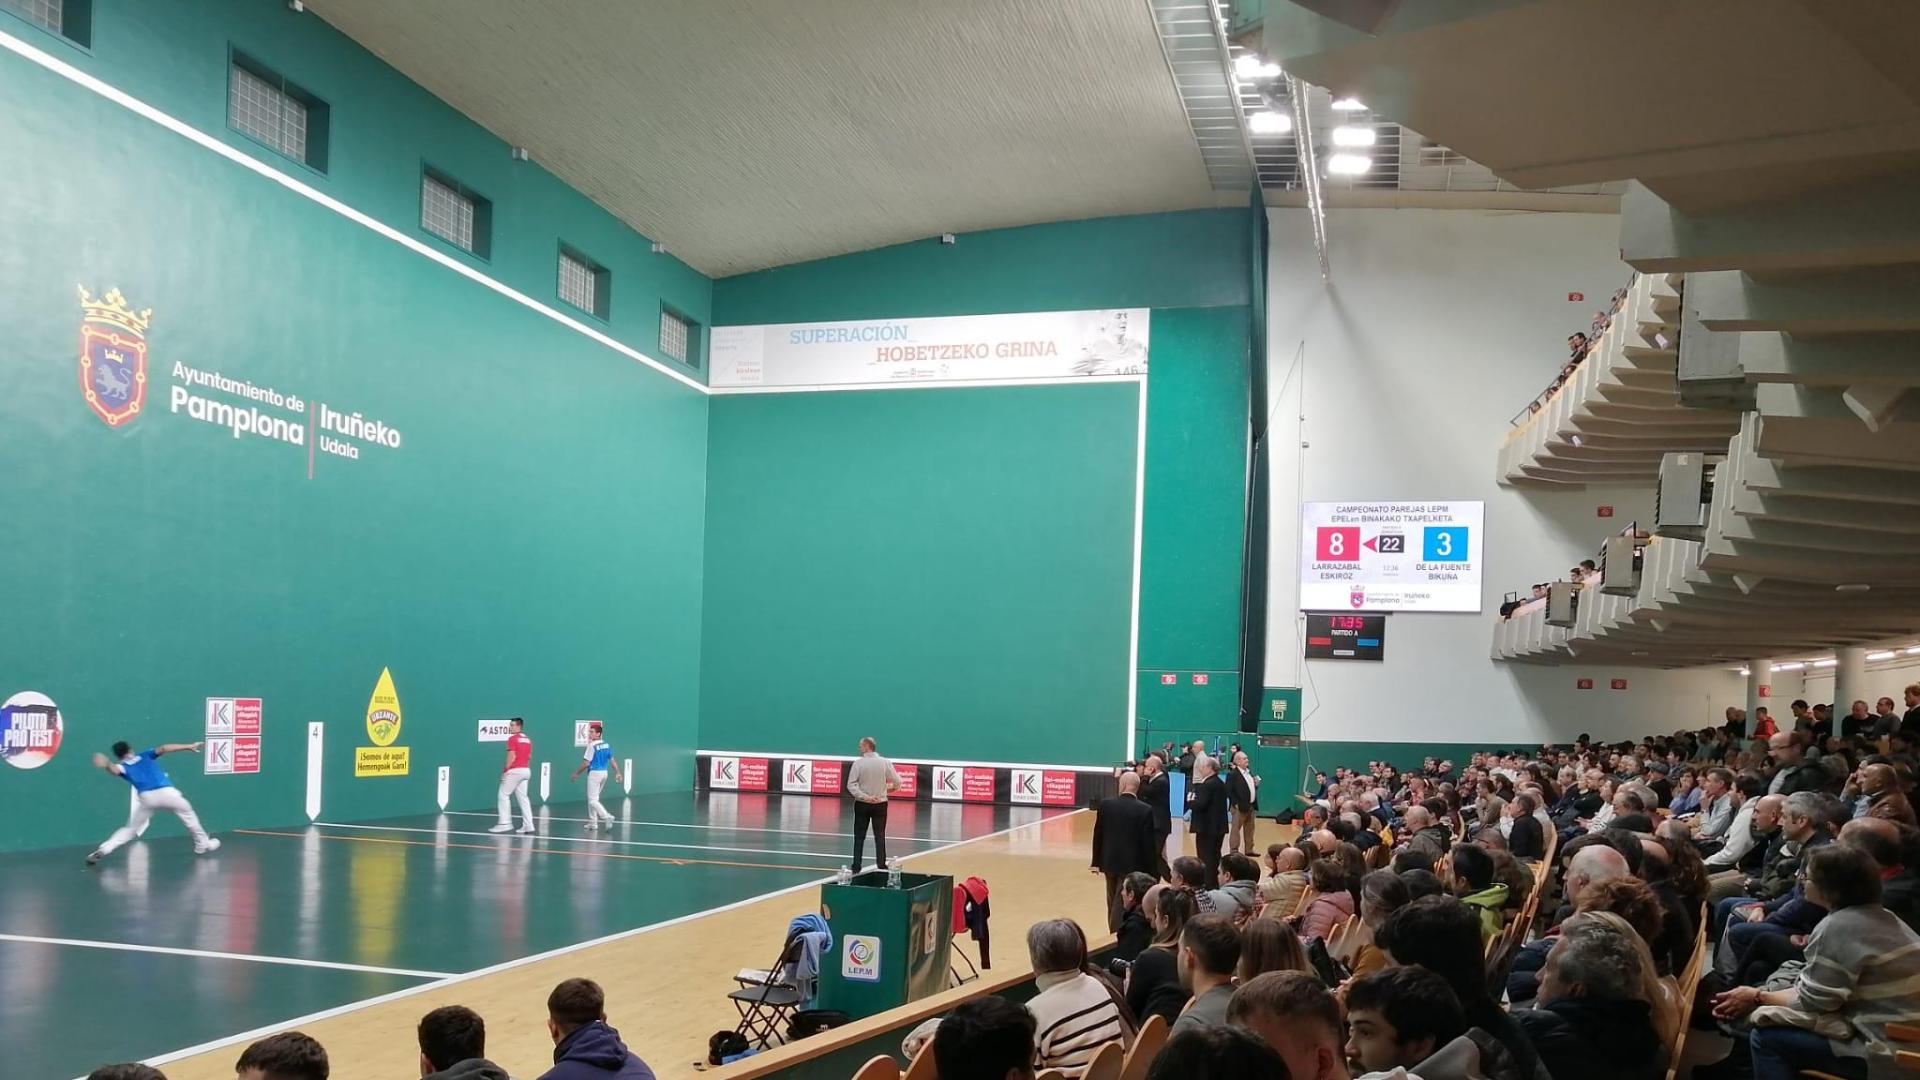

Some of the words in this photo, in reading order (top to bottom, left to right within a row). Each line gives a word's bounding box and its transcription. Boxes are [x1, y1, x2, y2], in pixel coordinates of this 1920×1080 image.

[995, 340, 1058, 358] GRINA
[172, 360, 284, 407] Ayuntamiento
[286, 394, 304, 412] de
[171, 385, 304, 445] Pamplona
[320, 402, 401, 448] Iruñeko
[320, 435, 359, 459] Udala
[1336, 505, 1389, 513] CAMPEONATO
[1390, 505, 1425, 513] PAREJAS
[1427, 505, 1449, 513] LEPM
[1361, 515, 1401, 523] BINAKAKO
[1403, 514, 1453, 522] TXAPELKETA
[1329, 532, 1344, 556] 8
[1382, 537, 1400, 551] 22
[1436, 532, 1452, 556] 3
[1311, 563, 1362, 571] LARRAZABAL
[1320, 572, 1354, 580] ESKIROZ
[1416, 563, 1427, 571] DE
[1428, 563, 1439, 571] LA
[1440, 563, 1472, 571] FUENTE
[4, 729, 28, 748] PRO
[29, 729, 54, 748] FEST
[312, 725, 318, 740] 4
